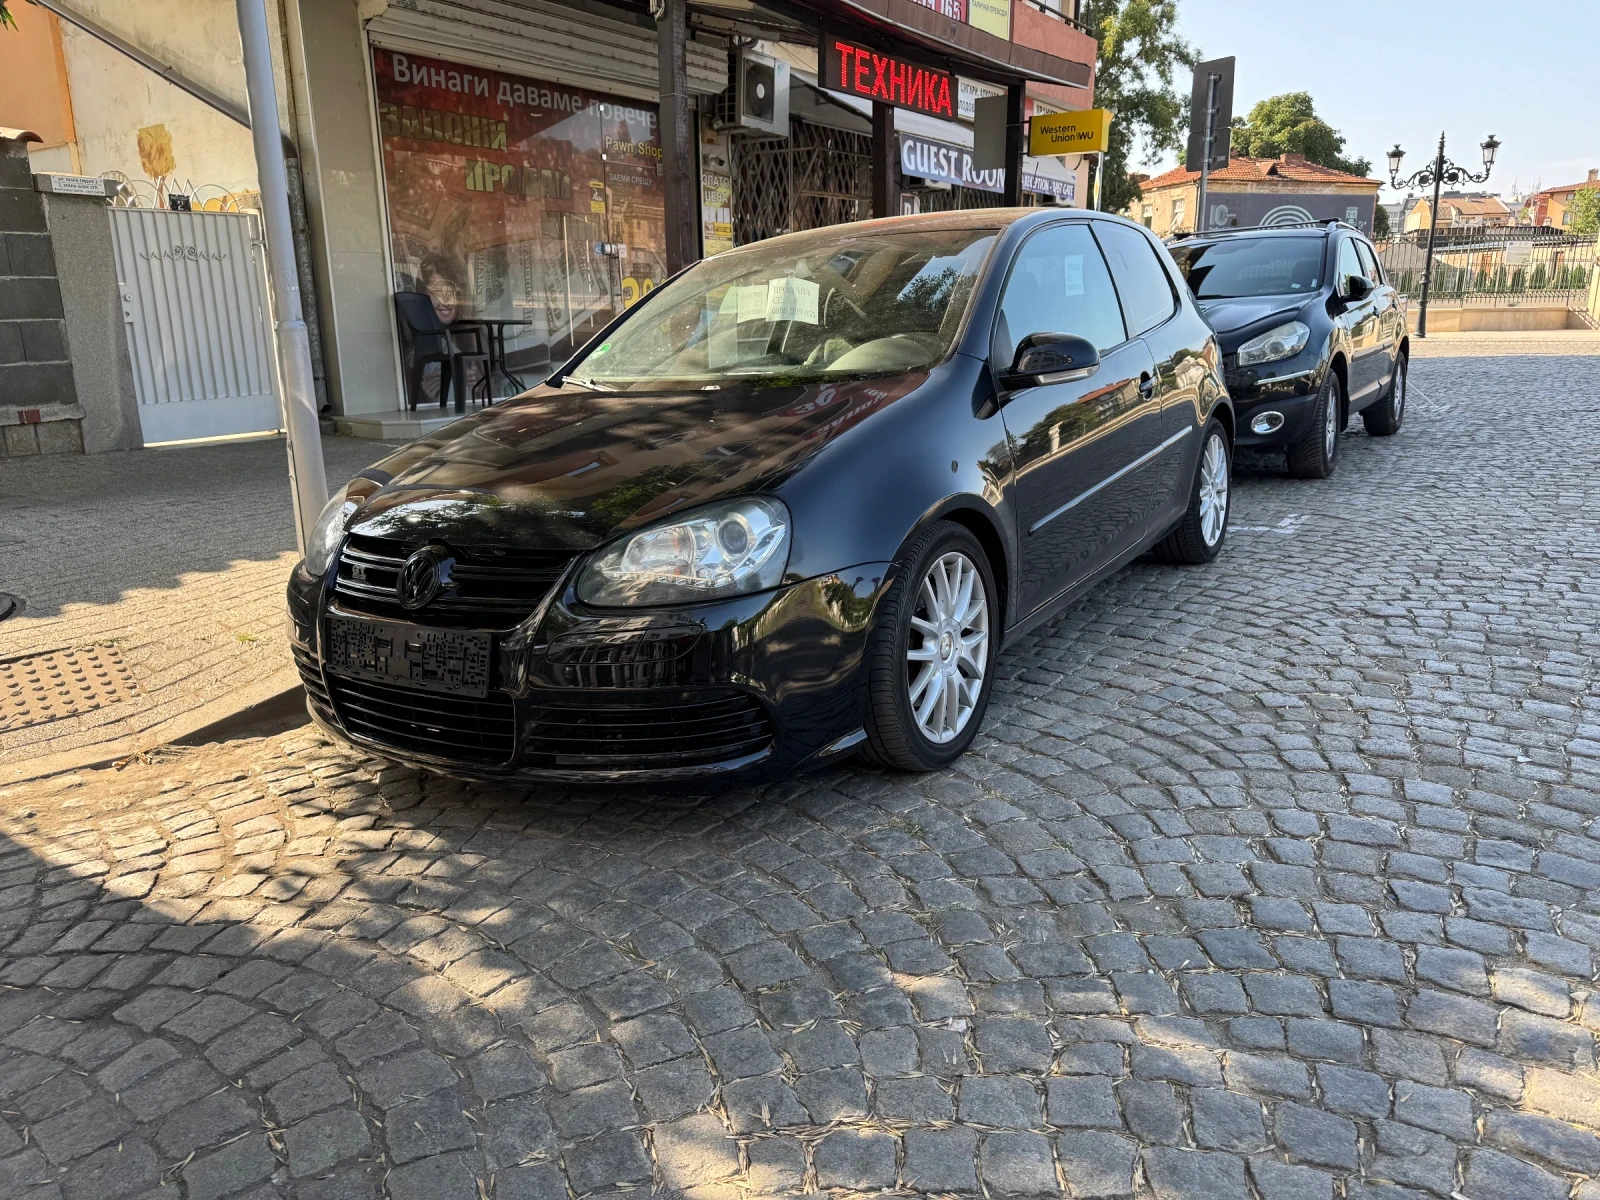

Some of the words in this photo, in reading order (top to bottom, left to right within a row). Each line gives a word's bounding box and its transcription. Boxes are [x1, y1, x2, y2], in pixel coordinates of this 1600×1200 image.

[392, 53, 489, 98] Винаги
[496, 80, 583, 114] даваме
[588, 98, 657, 129] повече
[834, 41, 953, 117] ТЕХНИКА
[378, 101, 508, 151] ЗАЛОЖИ
[1040, 125, 1076, 135] Western
[1050, 132, 1076, 143] Union
[605, 135, 634, 153] Pawn
[638, 141, 663, 160] Shop
[903, 139, 958, 179] GUEST
[465, 159, 571, 203] ПРОДАЙ
[608, 173, 631, 183] ЗАЕМИ
[631, 175, 655, 187] СРЕЩУ:
[702, 174, 730, 188] ЗЛАТО
[704, 189, 728, 204] ЦЕНА
